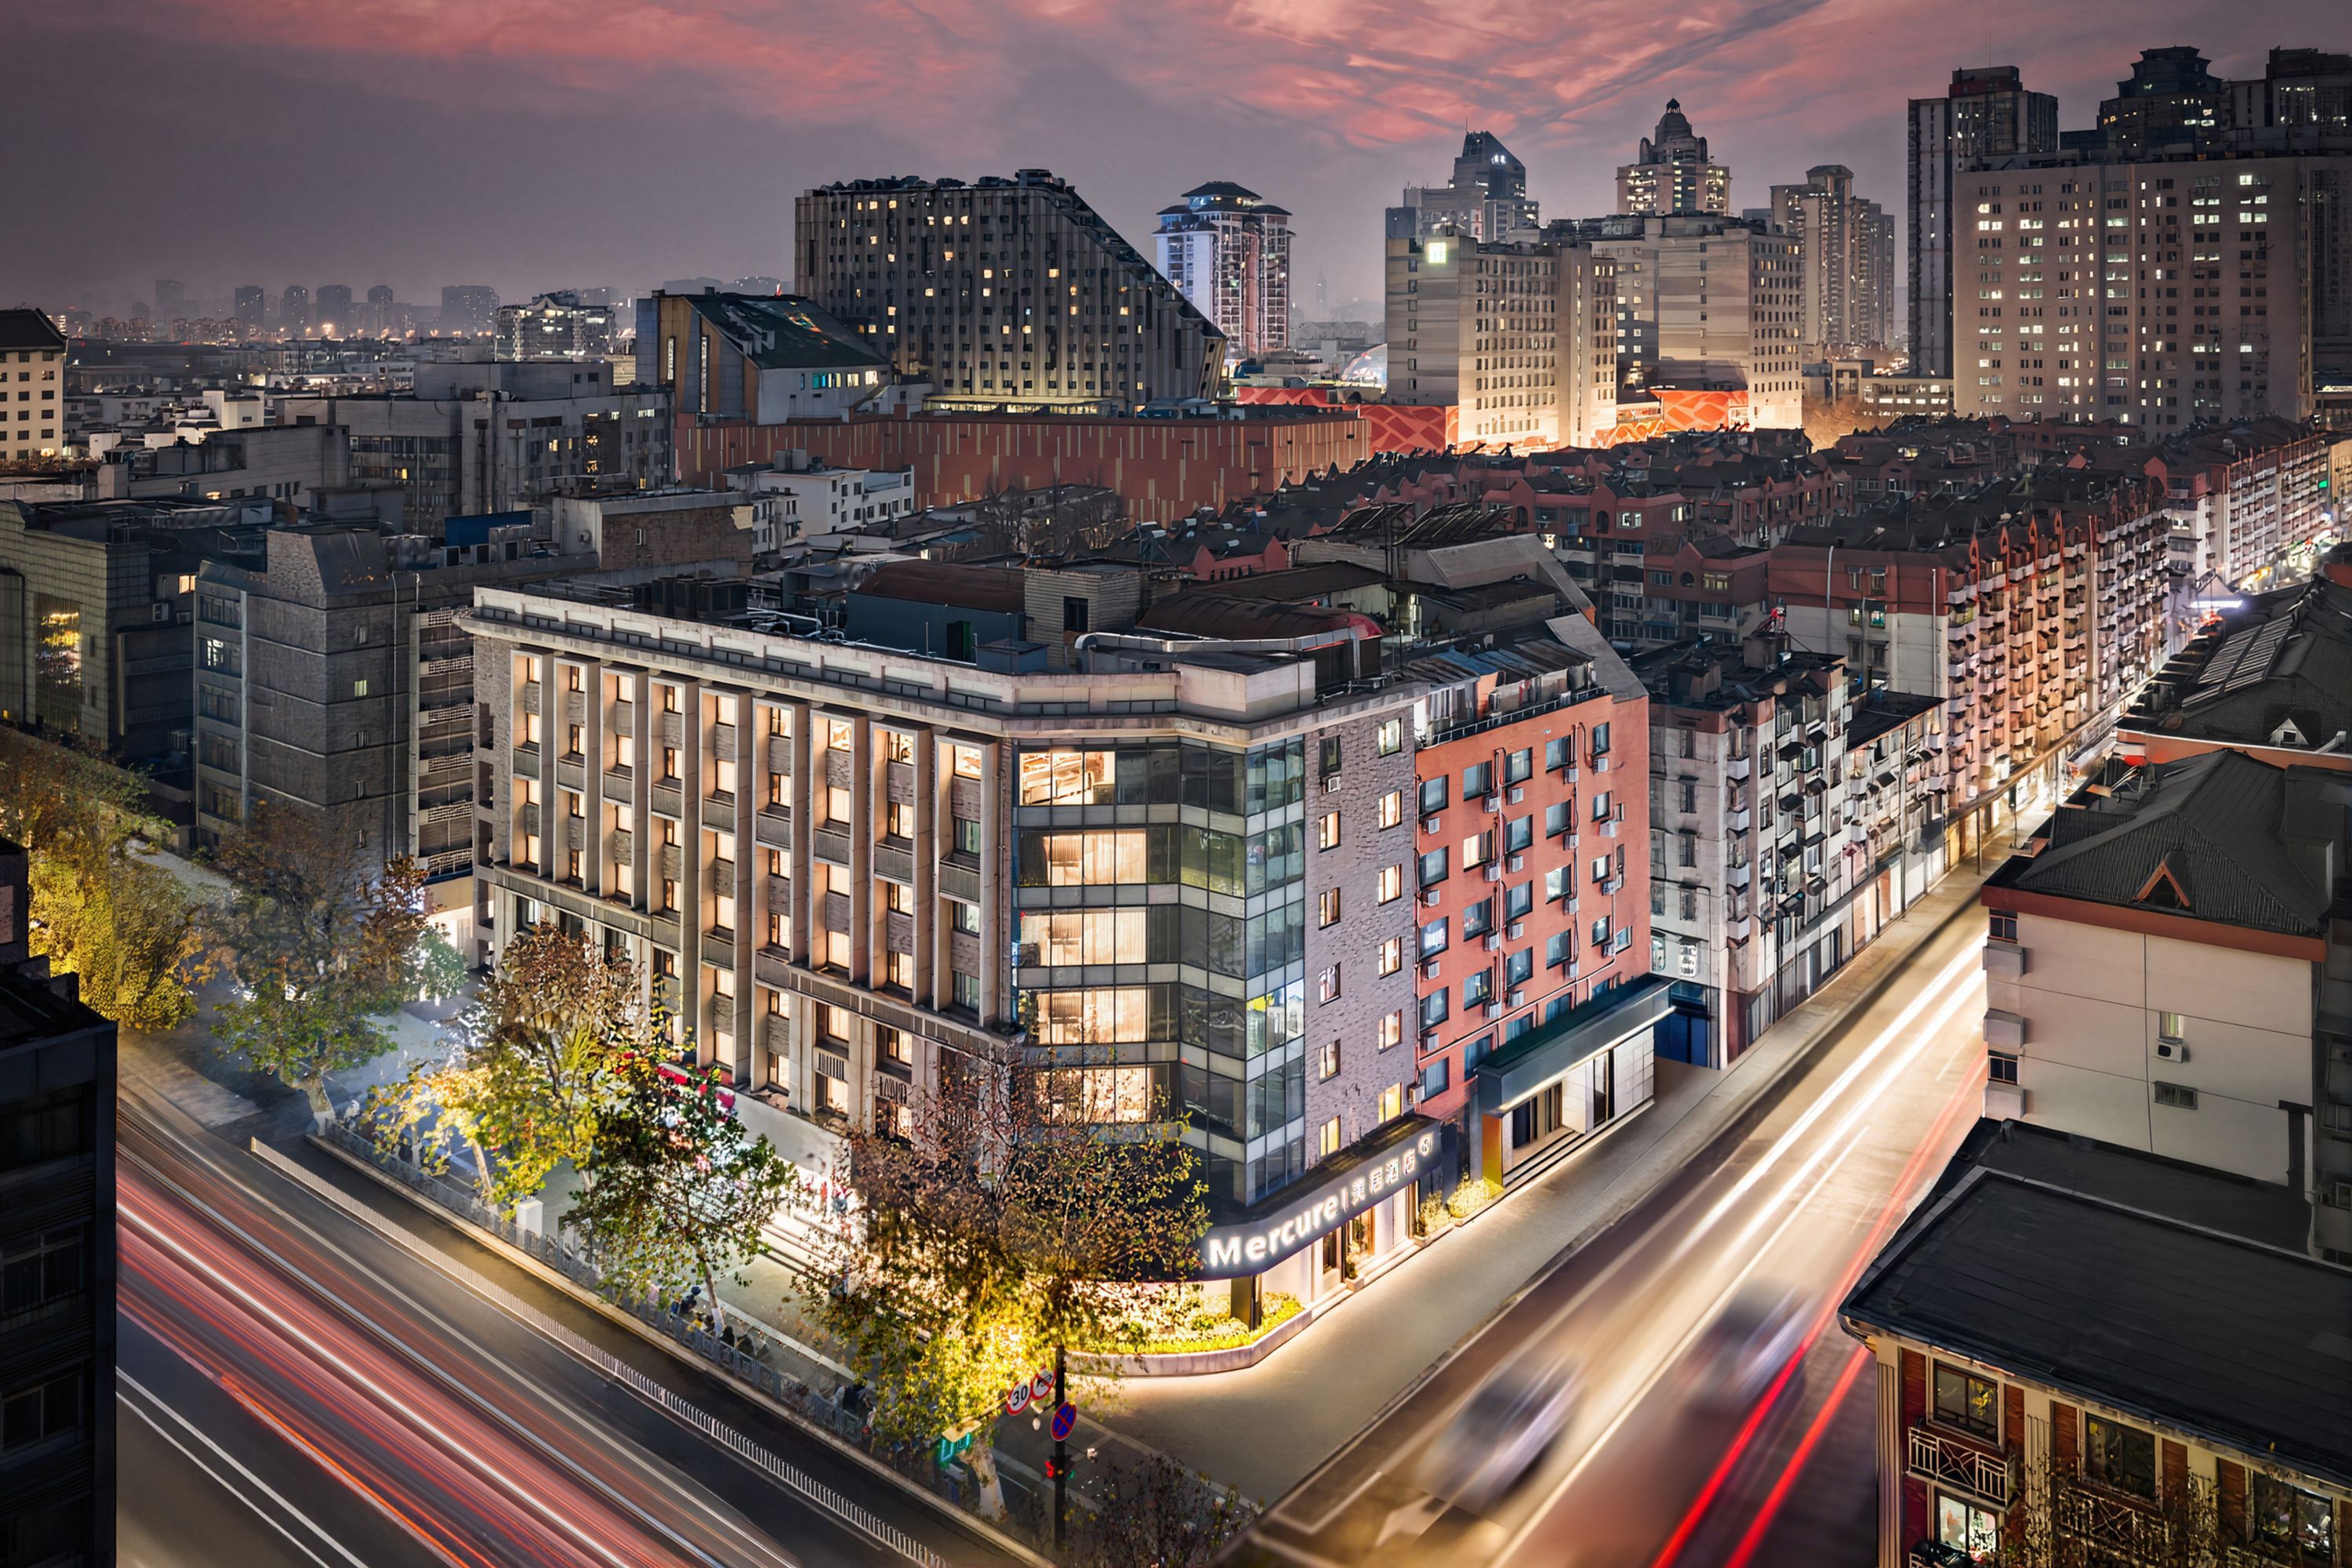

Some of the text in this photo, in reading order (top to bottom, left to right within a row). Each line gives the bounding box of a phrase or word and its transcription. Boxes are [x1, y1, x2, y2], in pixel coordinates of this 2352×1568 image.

[1352, 1149, 1416, 1205] 美居酒店
[1209, 1196, 1339, 1267] Mercure
[1012, 1385, 1028, 1406] 30
